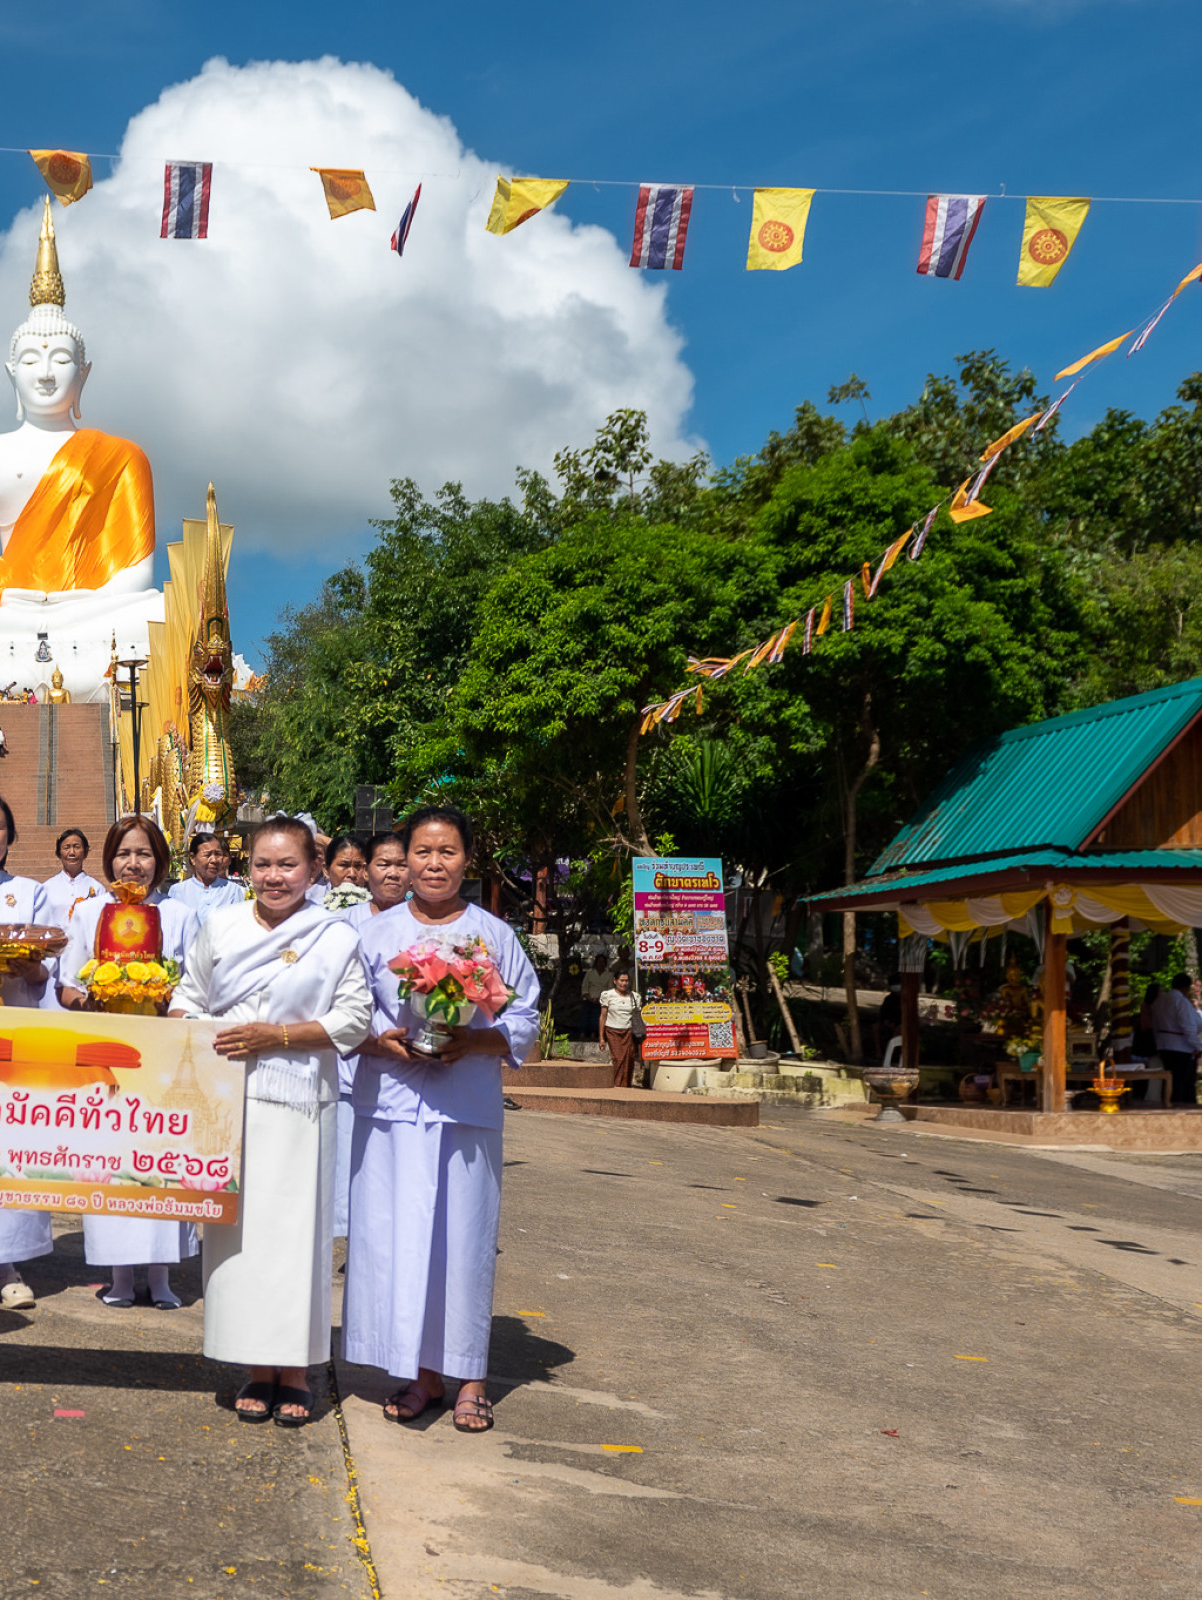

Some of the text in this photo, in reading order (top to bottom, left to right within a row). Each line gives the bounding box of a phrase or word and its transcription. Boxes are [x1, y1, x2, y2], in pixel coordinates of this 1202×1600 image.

[655, 872, 720, 889] ตักบาตรเทโว
[639, 940, 664, 953] 8-9
[8, 1145, 122, 1172] พุทธศักราช
[132, 1150, 229, 1178] ๒๕๖๘
[65, 1196, 87, 1208] ๘๑
[92, 1192, 103, 1209] ปี
[107, 1196, 223, 1218] หลวงพ่อธัมมชโย
